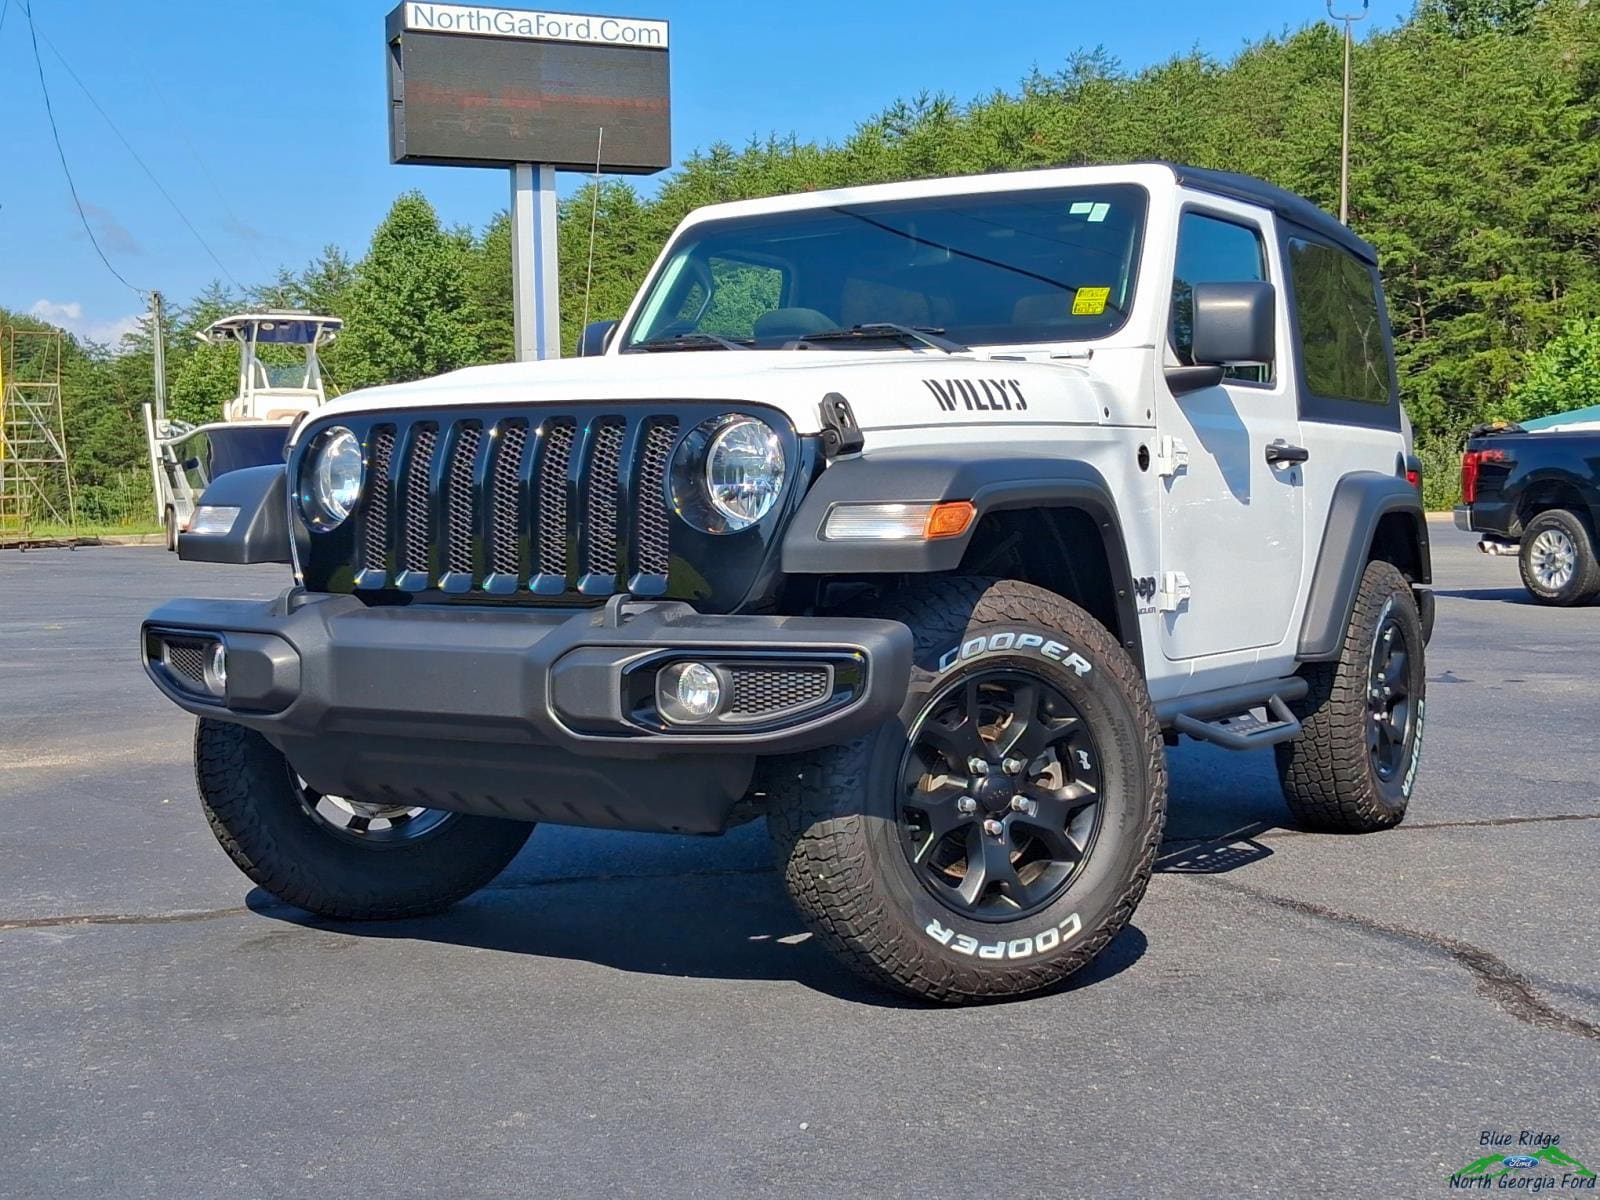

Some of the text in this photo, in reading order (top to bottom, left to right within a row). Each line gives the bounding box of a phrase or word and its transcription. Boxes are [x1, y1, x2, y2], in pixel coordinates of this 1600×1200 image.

[414, 5, 661, 44] NorthGaFord.Com
[921, 379, 1028, 411] WILLYS
[938, 632, 1092, 678] COOPER
[925, 912, 1082, 959] COOPER
